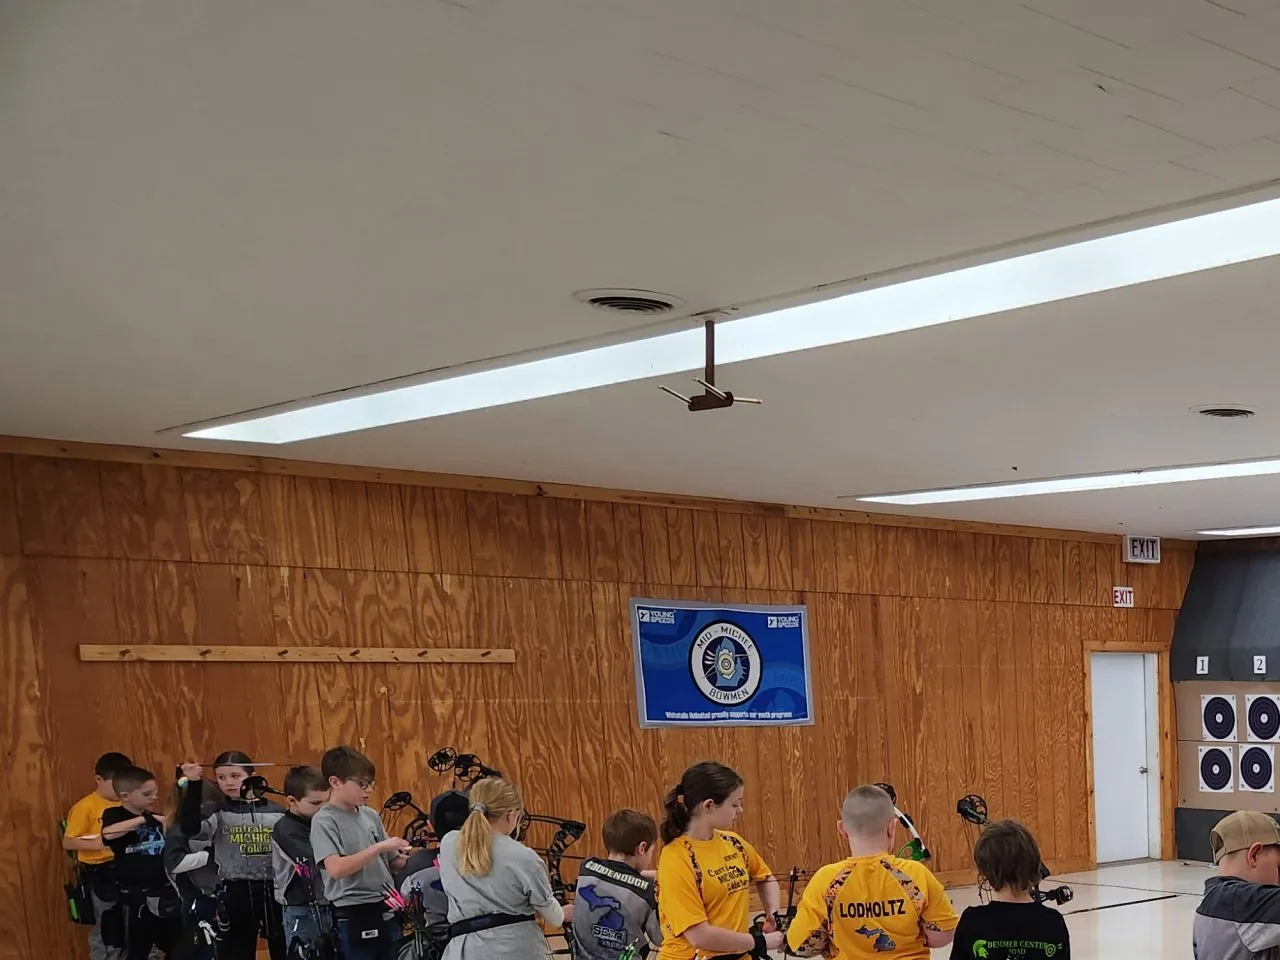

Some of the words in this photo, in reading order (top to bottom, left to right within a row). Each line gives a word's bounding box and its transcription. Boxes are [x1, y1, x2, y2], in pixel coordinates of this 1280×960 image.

[1131, 538, 1157, 559] EXIT
[1113, 590, 1133, 604] EXIT
[650, 610, 675, 618] YOUNG
[1200, 659, 1205, 671] 1
[1256, 659, 1263, 670] 2
[709, 687, 749, 701] BOWMEN
[230, 833, 272, 843] MICHIG
[584, 860, 650, 891] GOODENOUGH
[839, 898, 907, 919] LODHOLTZ
[987, 940, 1018, 949] DEMMER
[1019, 940, 1048, 950] CENTER
